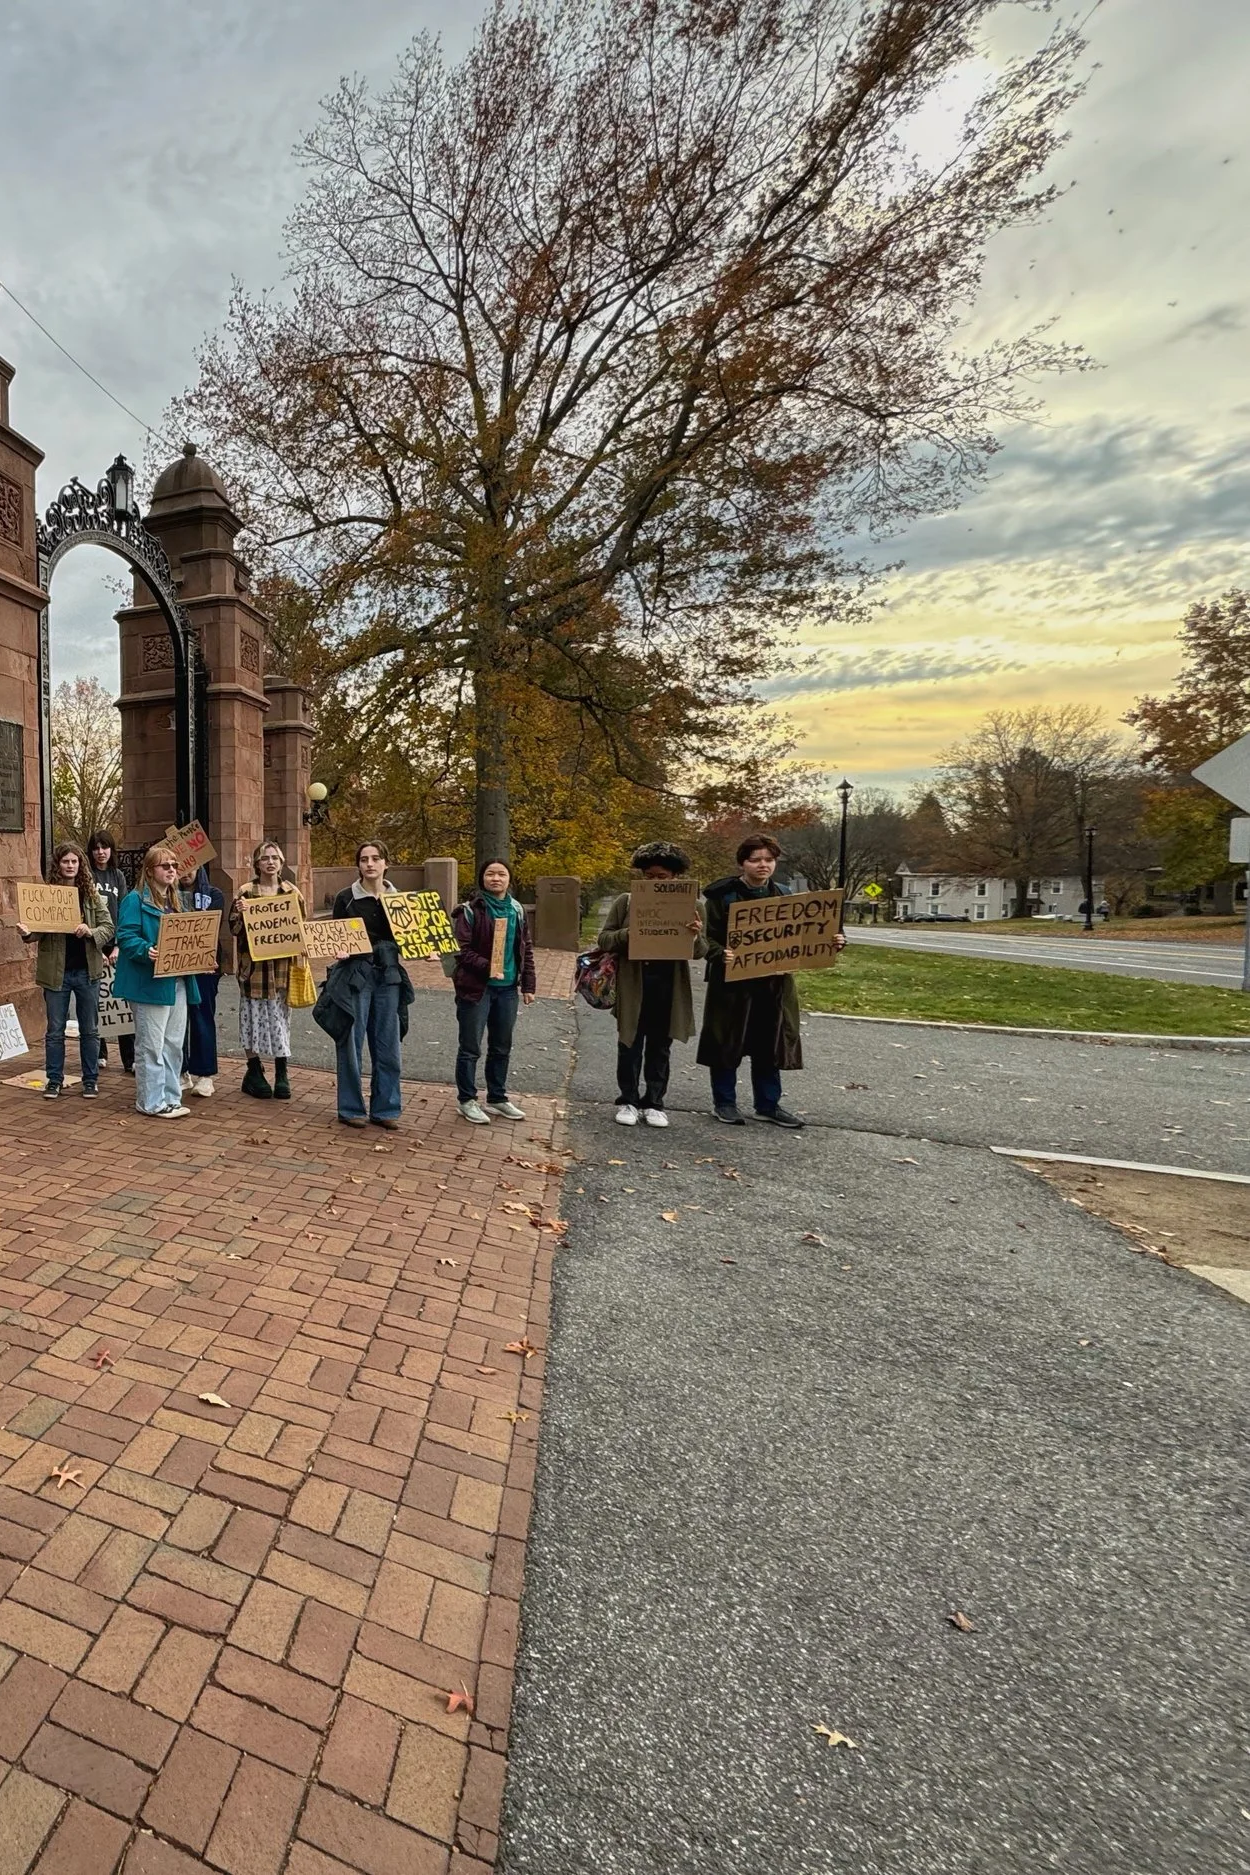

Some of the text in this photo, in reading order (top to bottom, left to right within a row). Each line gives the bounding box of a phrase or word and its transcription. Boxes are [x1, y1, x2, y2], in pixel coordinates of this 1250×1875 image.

[186, 831, 205, 849] NO
[22, 888, 74, 905] FUCK YOUR
[406, 891, 441, 911] STEP
[25, 906, 74, 922] COMPACT
[249, 900, 291, 915] PROTECT
[734, 899, 838, 930] FREEDOM
[165, 917, 215, 933] PROTECT
[247, 916, 298, 932] ACADEMIC
[430, 909, 451, 927] OR
[303, 920, 347, 935] PROTECT
[638, 928, 679, 936] STUDENTS
[743, 920, 830, 946] SECURITY
[166, 933, 212, 953] TRANS
[254, 932, 301, 946] FREEDOM
[313, 930, 367, 943] ACADEMIC
[306, 941, 362, 958] FREEDOM
[401, 941, 436, 960] ASIDE
[731, 943, 835, 971] AFFODABILITY
[163, 949, 216, 972] STUDENTS
[0, 1027, 25, 1052] RISE
